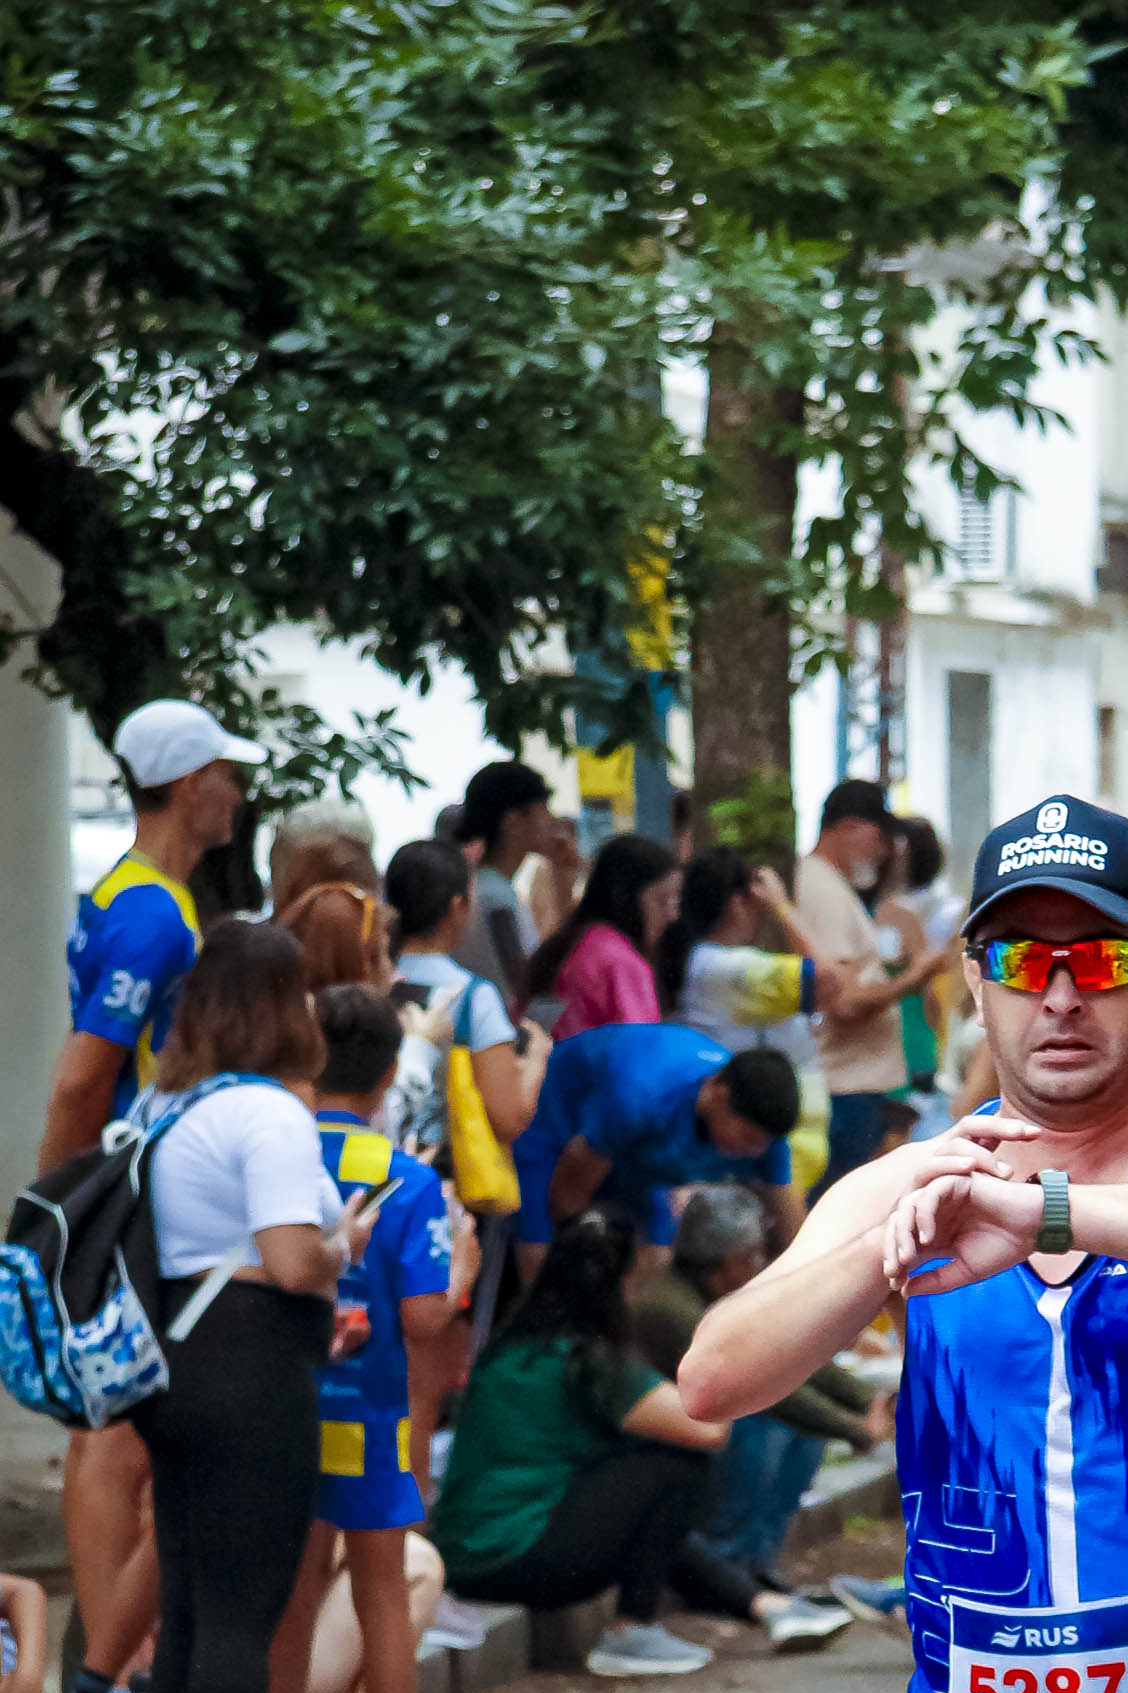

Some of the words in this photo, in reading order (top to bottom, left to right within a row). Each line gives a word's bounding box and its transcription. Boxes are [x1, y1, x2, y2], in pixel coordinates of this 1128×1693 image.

[1001, 833, 1108, 860] ROSARIO
[998, 849, 1105, 876] RUNNING
[103, 969, 151, 1016] 30
[1024, 1626, 1079, 1647] RUS
